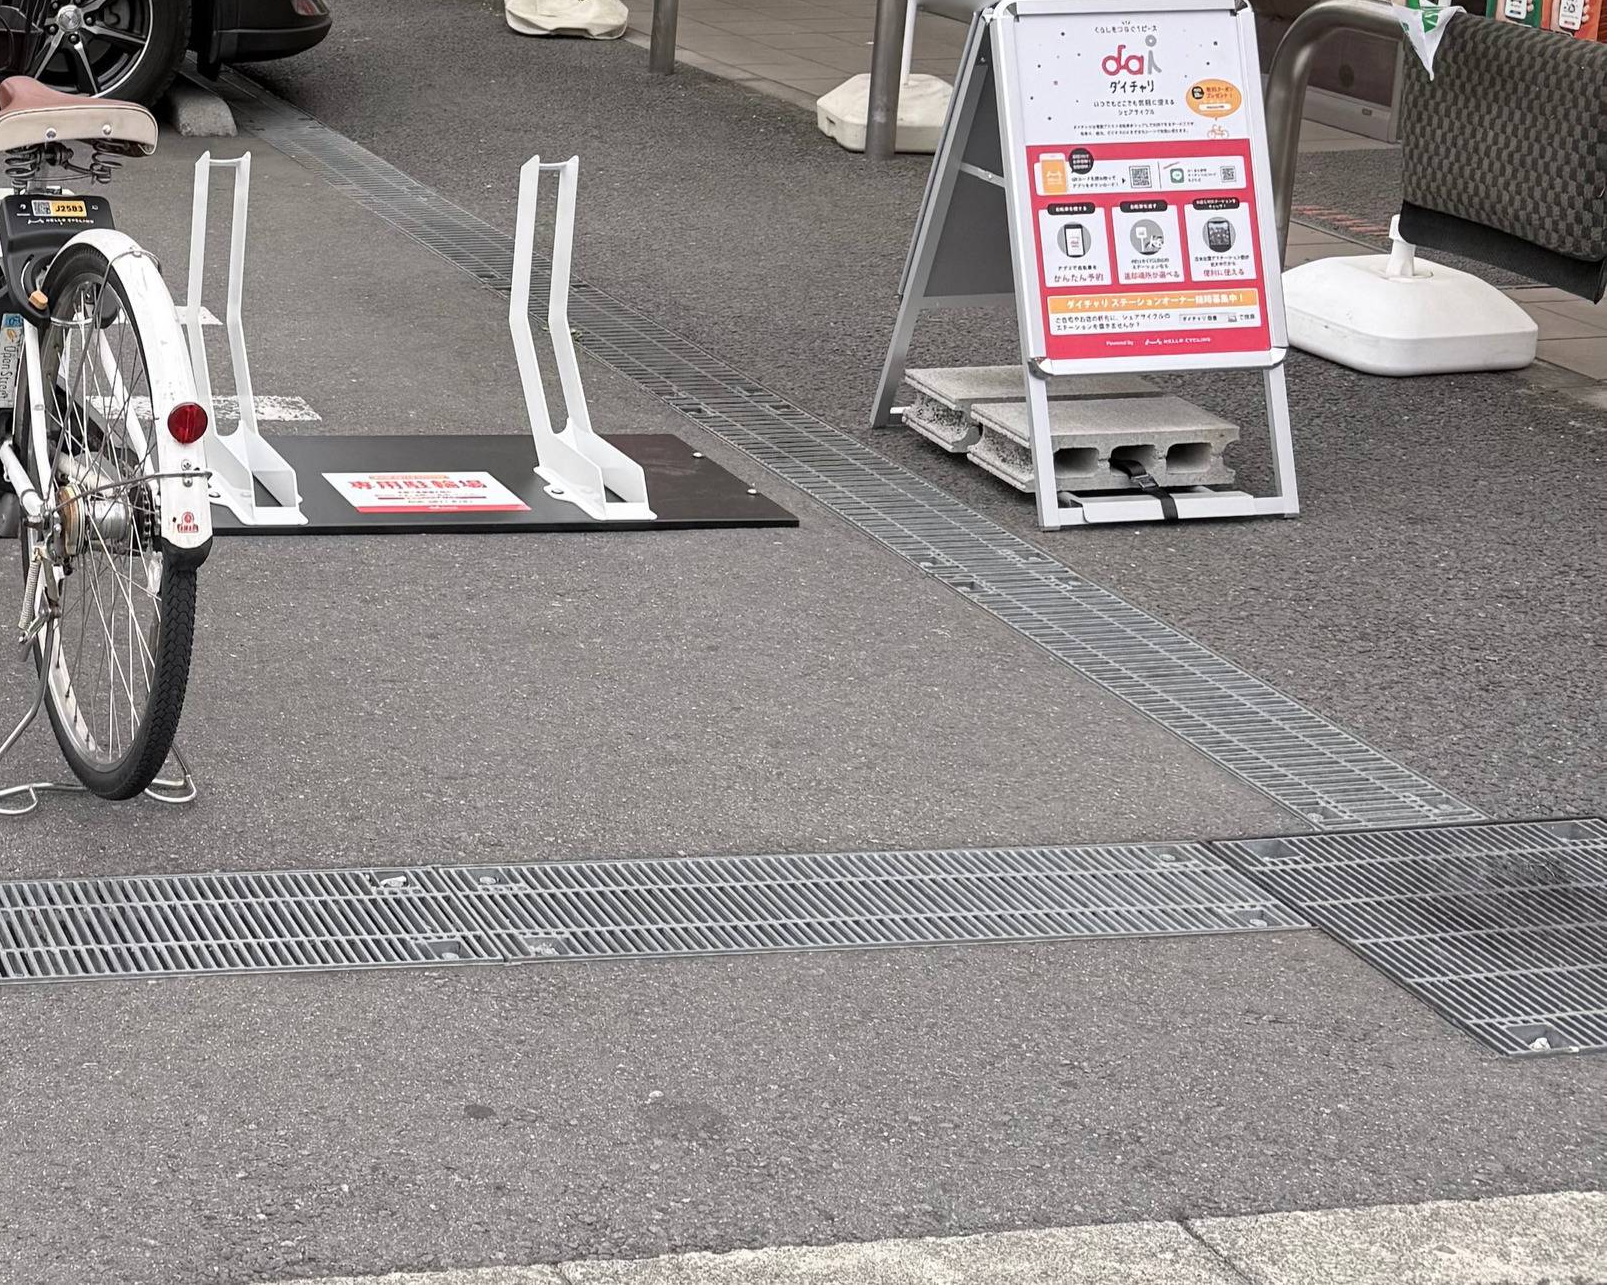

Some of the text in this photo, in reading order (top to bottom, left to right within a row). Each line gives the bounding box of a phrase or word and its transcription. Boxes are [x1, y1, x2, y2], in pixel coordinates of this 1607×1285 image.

[1109, 80, 1155, 94] ダイチャリ
